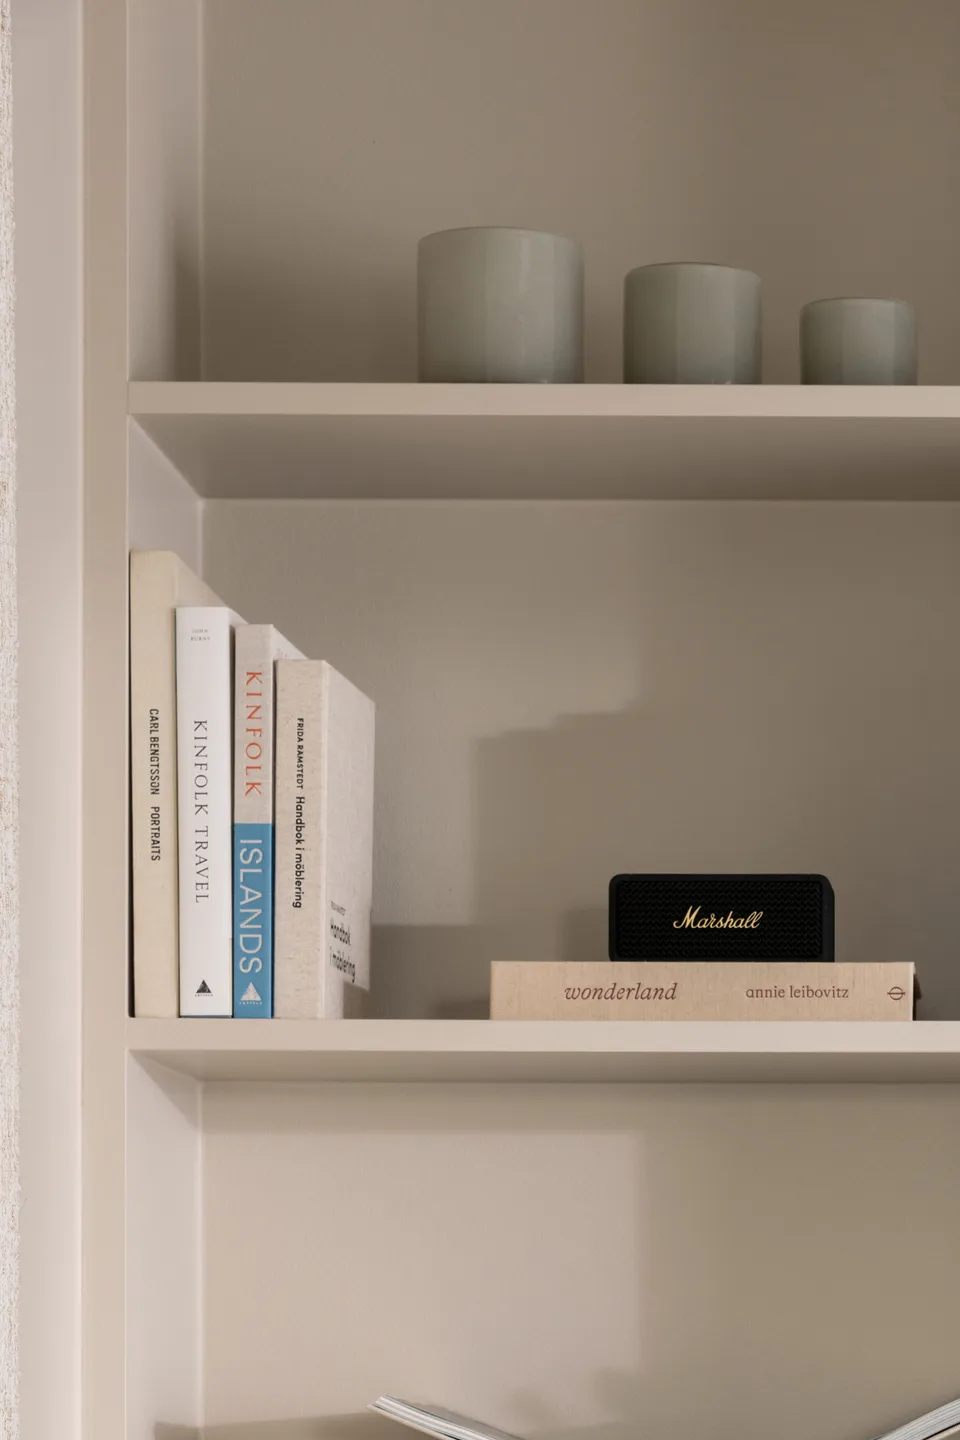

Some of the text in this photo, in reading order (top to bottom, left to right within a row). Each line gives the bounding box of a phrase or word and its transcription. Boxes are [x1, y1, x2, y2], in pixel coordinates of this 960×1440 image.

[244, 671, 263, 797] KINFOLK
[296, 717, 305, 743] FRIDA
[149, 708, 161, 862] CARL BENGTSSON PORTRAITS
[296, 745, 304, 789] RAMSTEDT
[193, 720, 210, 903] KINFOLK TRAVEL
[295, 796, 306, 845] Handbok
[239, 839, 263, 973] ISLANDS
[292, 853, 305, 909] möblering
[672, 905, 764, 929] Marshall
[564, 982, 849, 1001] wonderland annie leibovitz
